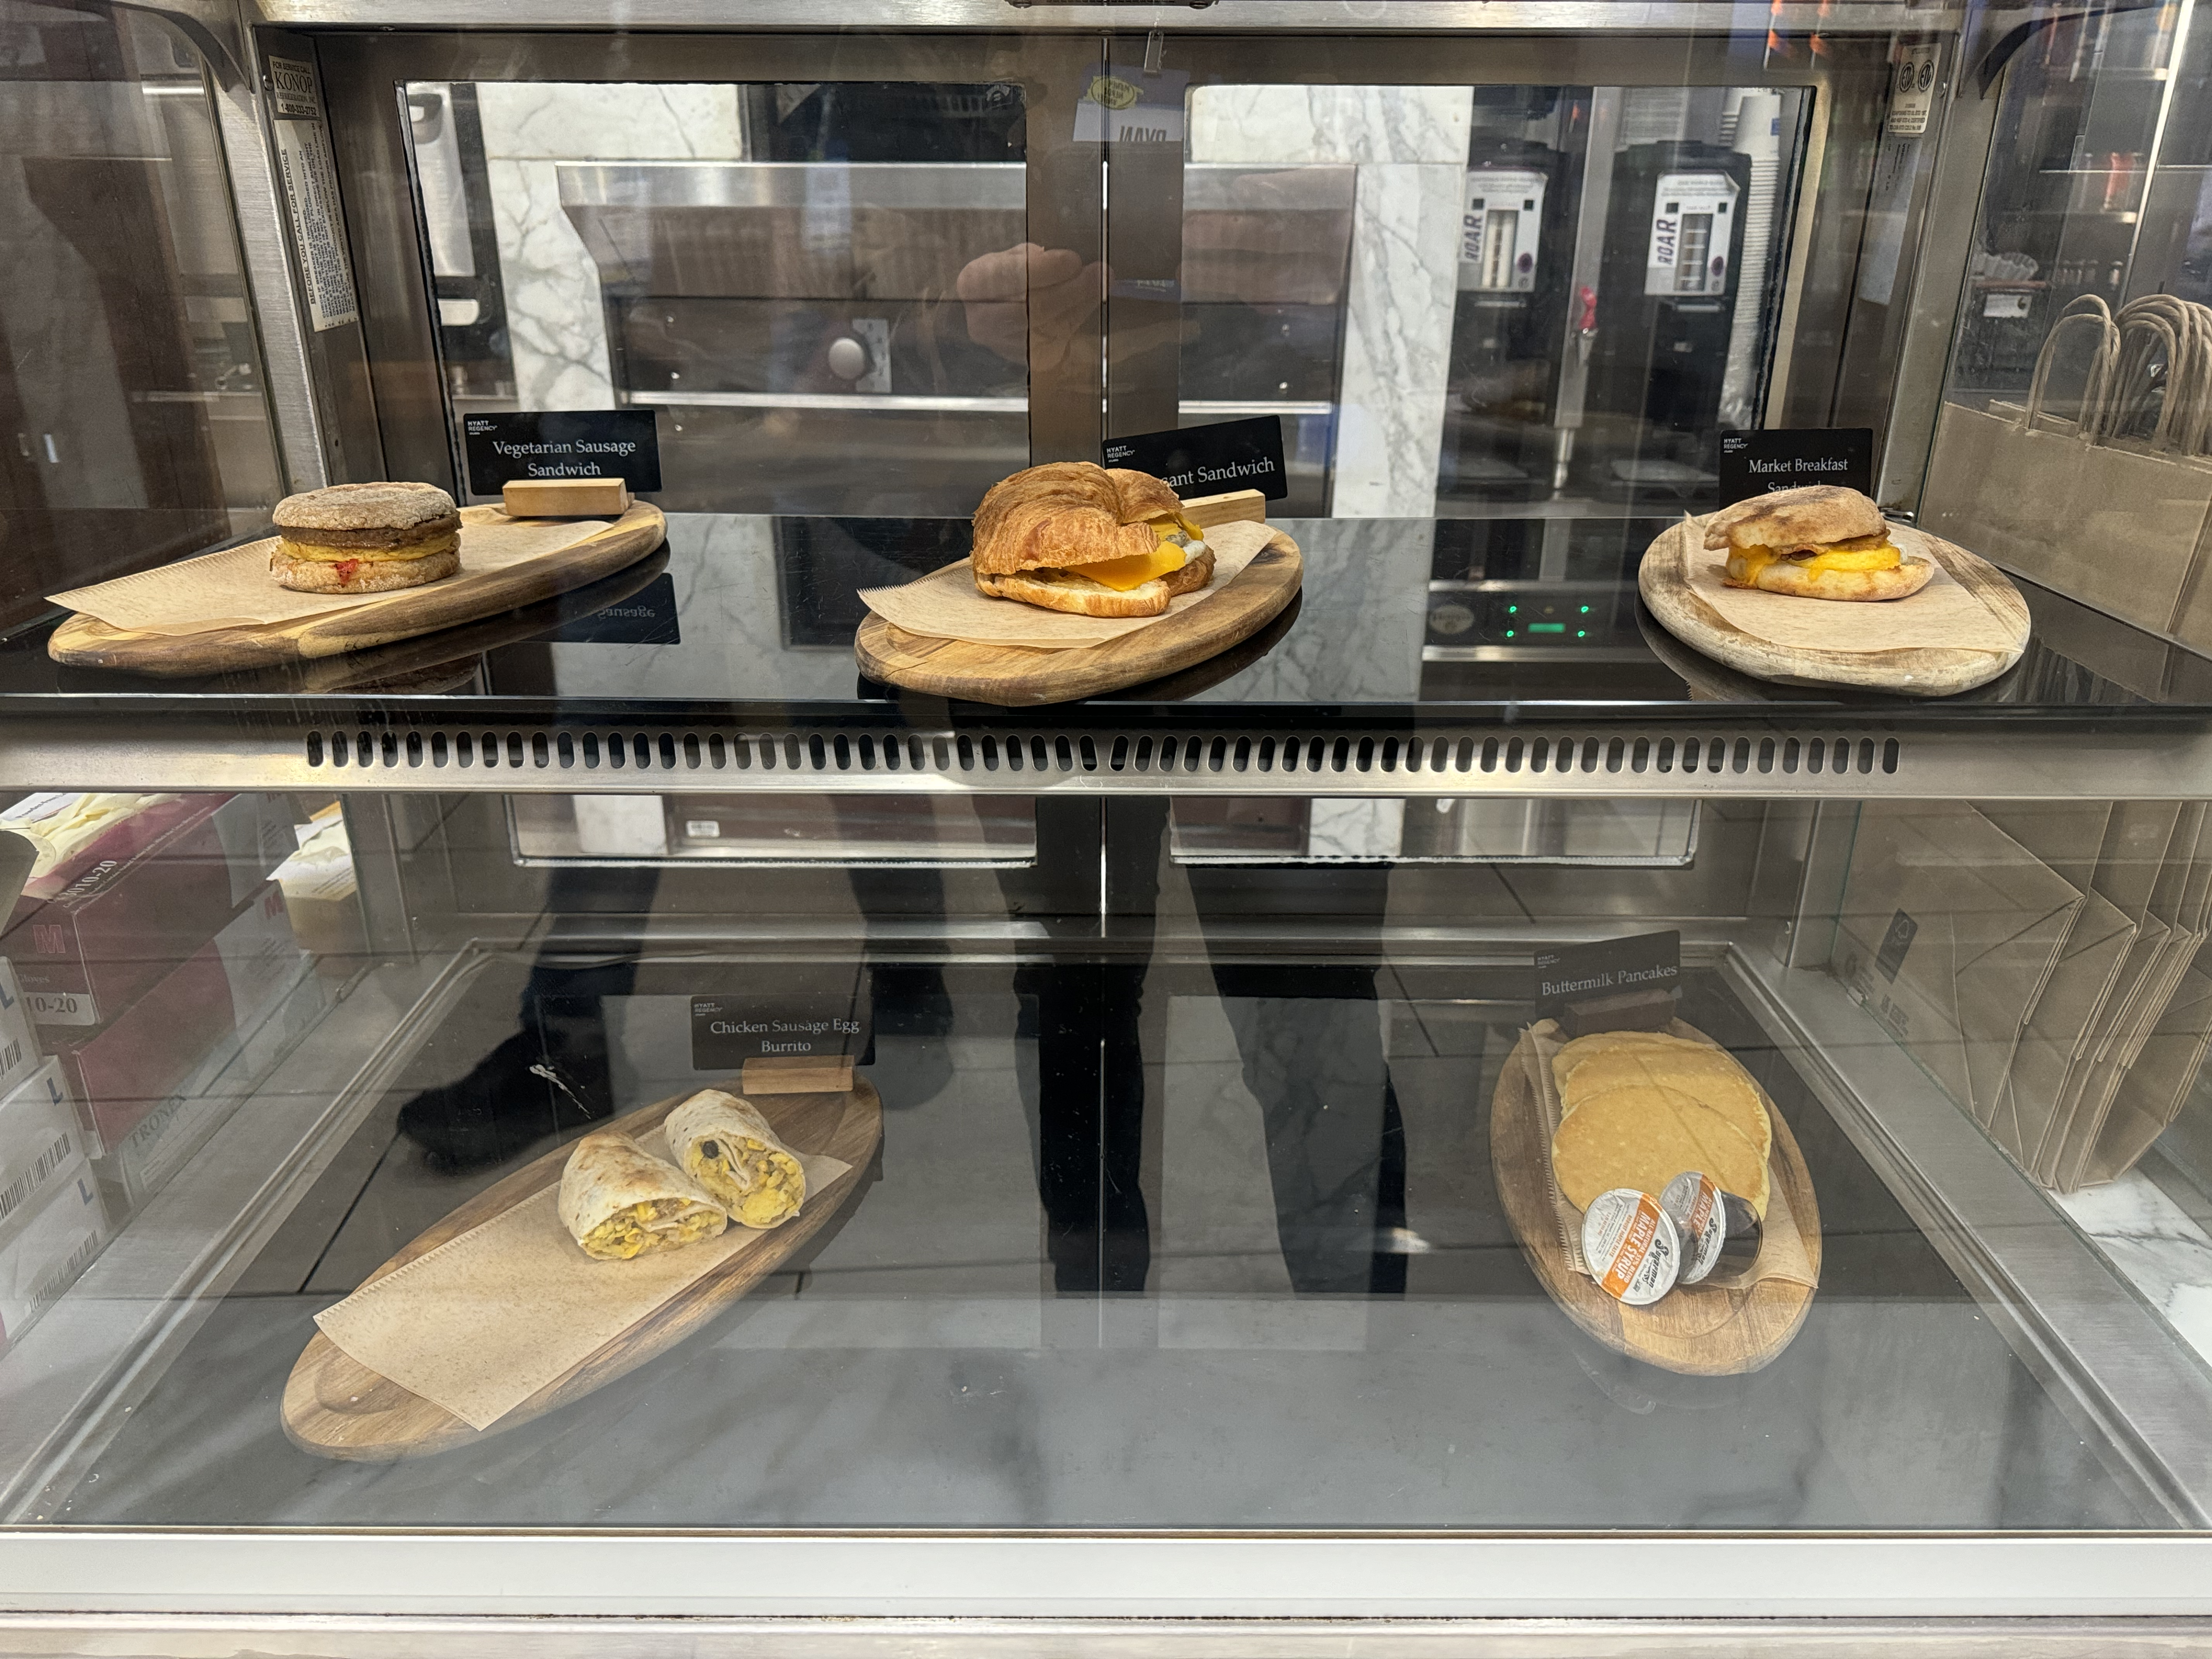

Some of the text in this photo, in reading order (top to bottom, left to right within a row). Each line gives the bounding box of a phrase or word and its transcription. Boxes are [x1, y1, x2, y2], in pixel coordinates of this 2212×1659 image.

[272, 61, 310, 74] FOR SERVICE CALL
[274, 71, 313, 93] KONOP
[304, 181, 314, 216] PLUGGED
[281, 149, 315, 305] BEFORE YOU CALL FOR SERVICE
[330, 223, 339, 256] PRODUCT
[1656, 218, 1677, 265] ROAR
[310, 251, 319, 284] BREAKER
[493, 439, 636, 459] Vegetarian Sausage
[1107, 445, 1127, 453] HYATT
[1108, 450, 1135, 459] REGENCY
[528, 462, 601, 477] Sandwich
[1198, 457, 1275, 483] Sandwich
[1748, 457, 1848, 473] Market Breakfast
[33, 925, 66, 953] M
[1542, 964, 1678, 996] Buttermilk Pancakes
[710, 1018, 860, 1035] Chicken Sausage Egg
[761, 1040, 811, 1053] Burrito
[46, 1077, 64, 1106] L
[77, 1178, 94, 1206] L
[1692, 1191, 1709, 1228] MAPLE
[1609, 1214, 1632, 1257] ROBUST MAPLE TASTE
[1630, 1211, 1651, 1248] MAPLE
[1698, 1218, 1717, 1264] Sugarman
[1615, 1244, 1638, 1279] SYRUP
[1632, 1253, 1642, 1266] 55%
[1648, 1238, 1668, 1288] Sugarman
[1623, 1265, 1635, 1283] BLEND
